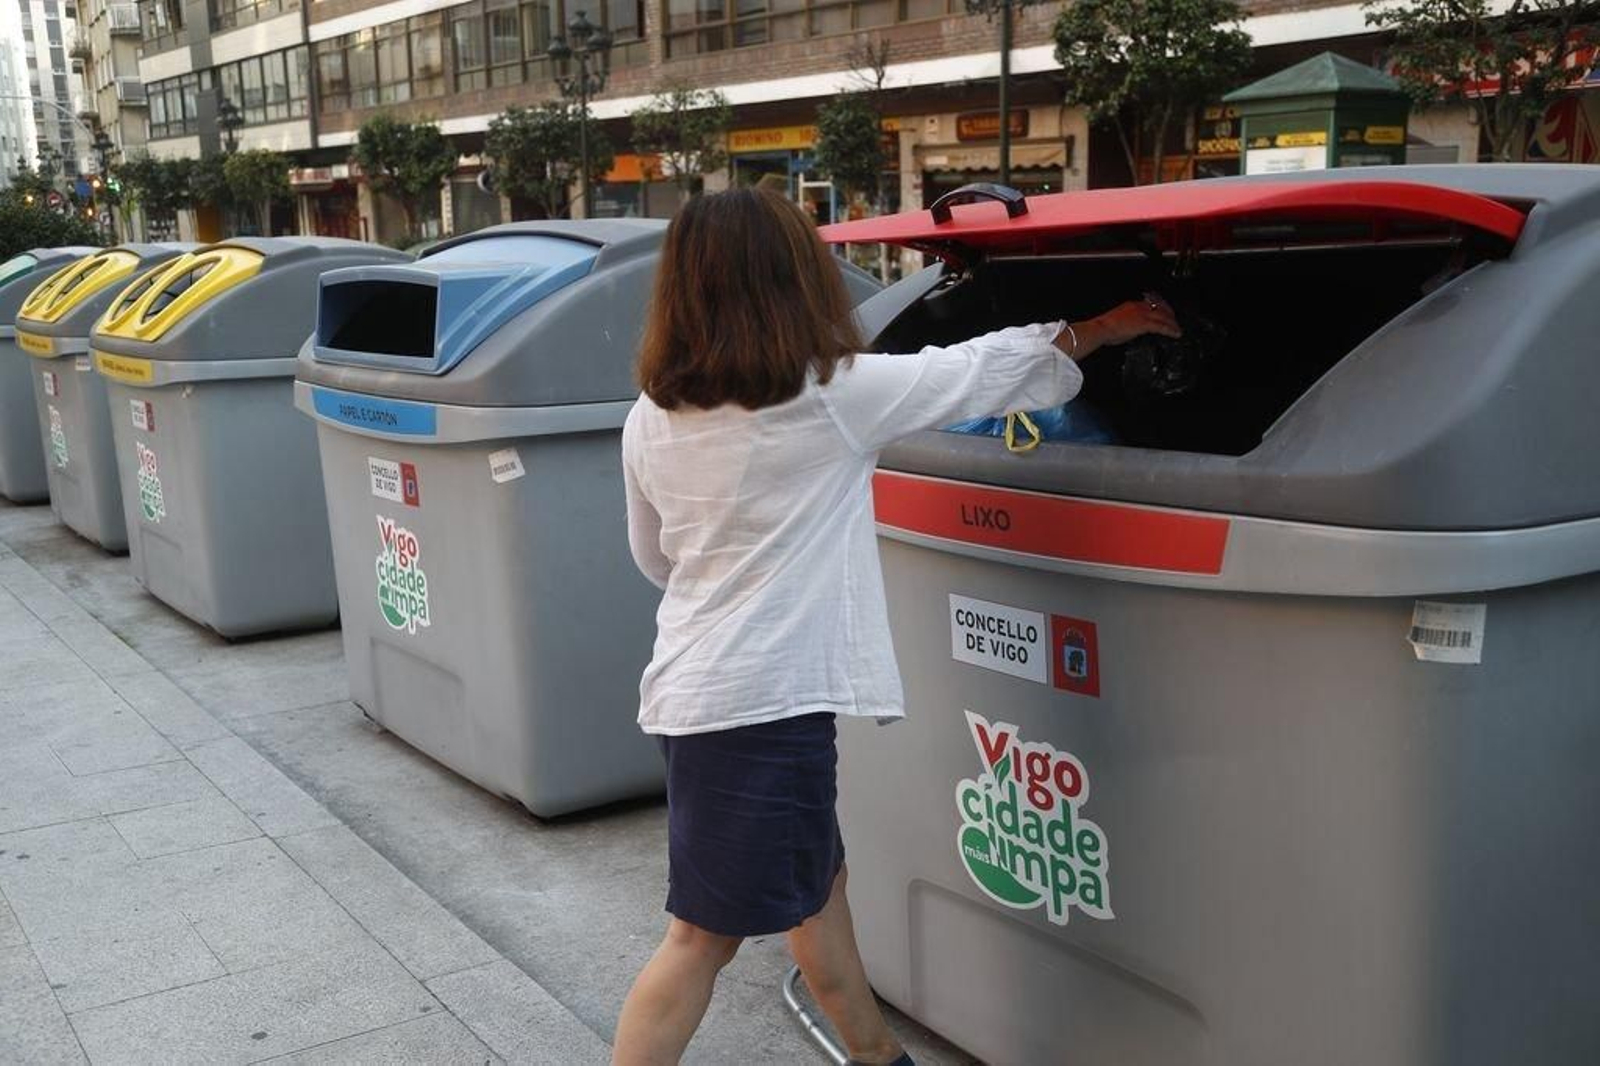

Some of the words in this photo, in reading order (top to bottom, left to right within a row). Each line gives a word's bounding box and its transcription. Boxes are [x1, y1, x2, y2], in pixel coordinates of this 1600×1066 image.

[371, 463, 399, 481] CONCELLO
[383, 480, 397, 493] VIGO
[961, 504, 1011, 532] LIXO
[380, 521, 417, 567] Vigo
[378, 553, 426, 596] cidade
[956, 608, 1038, 645] CONCELLO
[966, 632, 986, 654] DE
[989, 638, 1029, 664] VIGO
[974, 722, 1083, 812] Vigo
[961, 780, 1101, 868] cidade
[988, 822, 1104, 917] limpa
